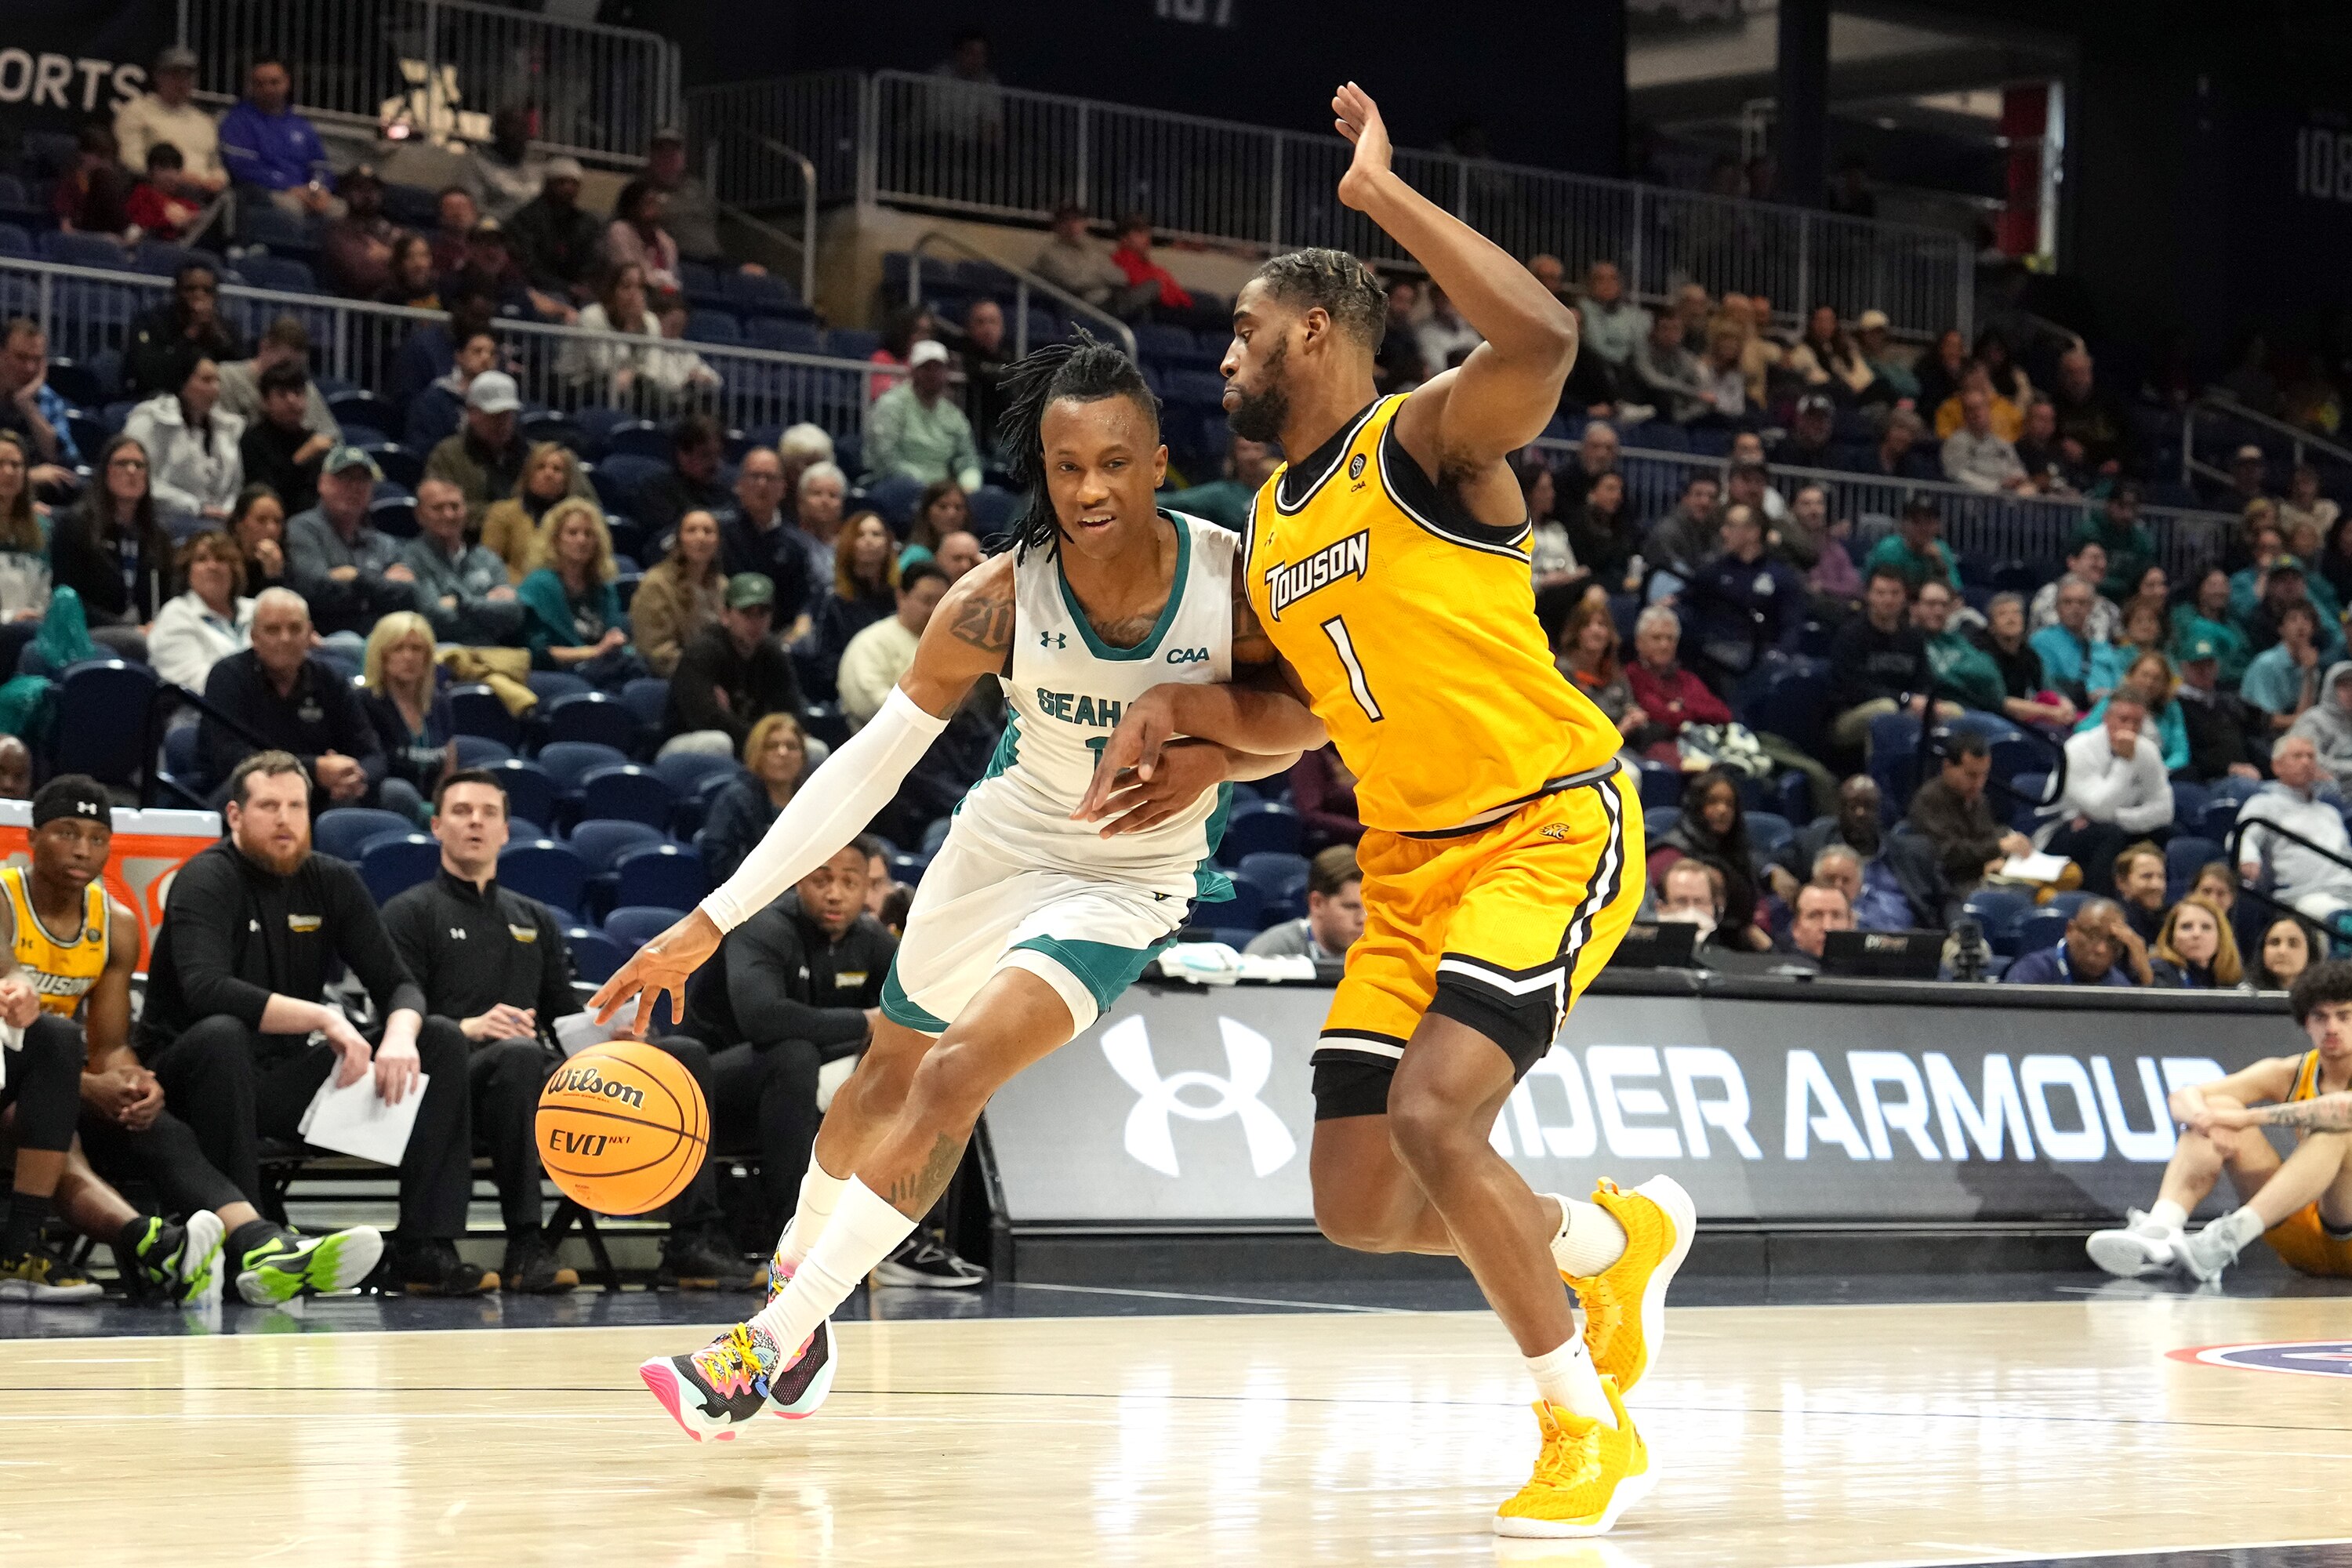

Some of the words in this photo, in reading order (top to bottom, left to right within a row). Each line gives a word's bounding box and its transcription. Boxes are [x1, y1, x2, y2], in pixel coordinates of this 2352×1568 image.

[1351, 481, 1367, 492] CAA
[1166, 647, 1210, 664] CAA
[1319, 614, 1385, 723] 1
[1036, 688, 1134, 728] SEAH
[548, 1068, 644, 1109] Wilson
[550, 1129, 608, 1156] EVO
